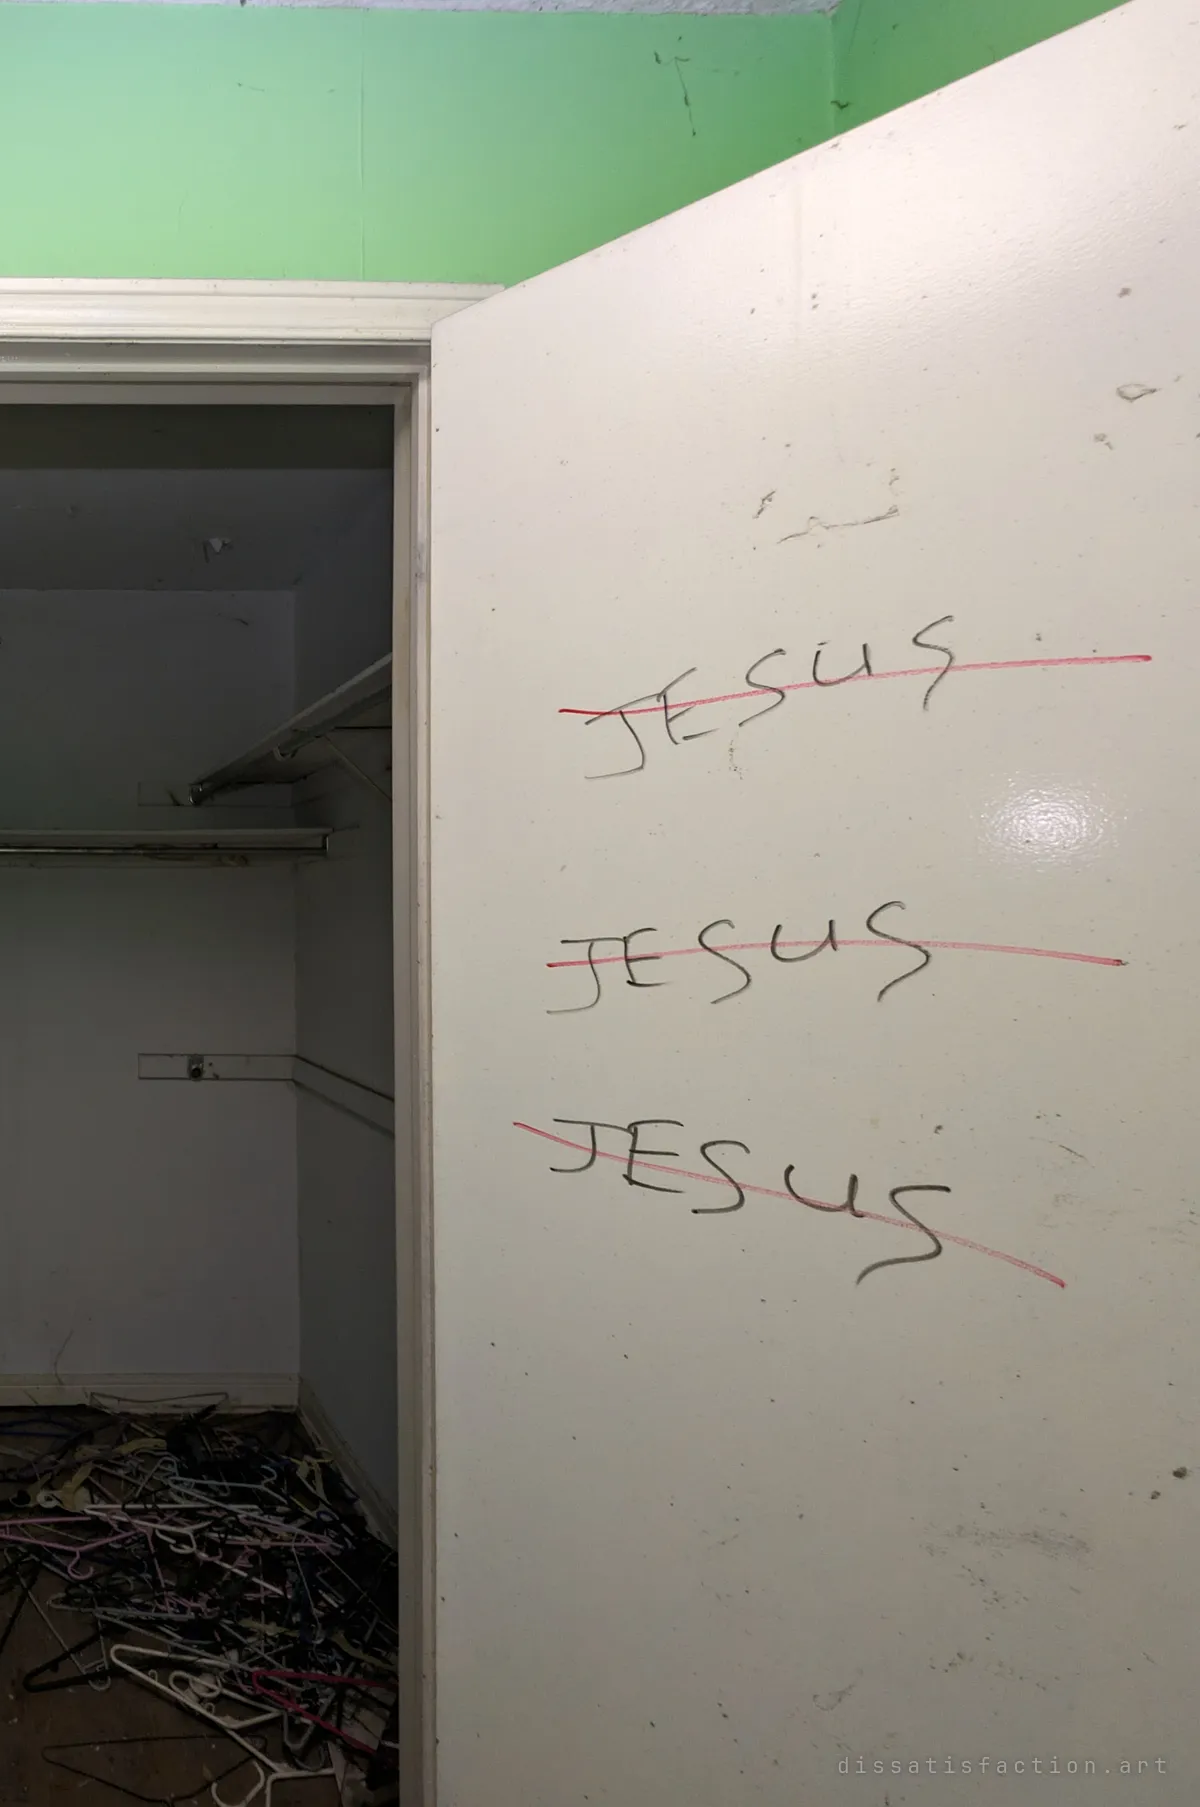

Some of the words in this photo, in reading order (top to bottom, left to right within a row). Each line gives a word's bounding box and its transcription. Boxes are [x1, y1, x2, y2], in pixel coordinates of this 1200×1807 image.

[583, 614, 956, 781] JESUS
[545, 900, 931, 1015] JESUS
[548, 1118, 952, 1285] JESUS
